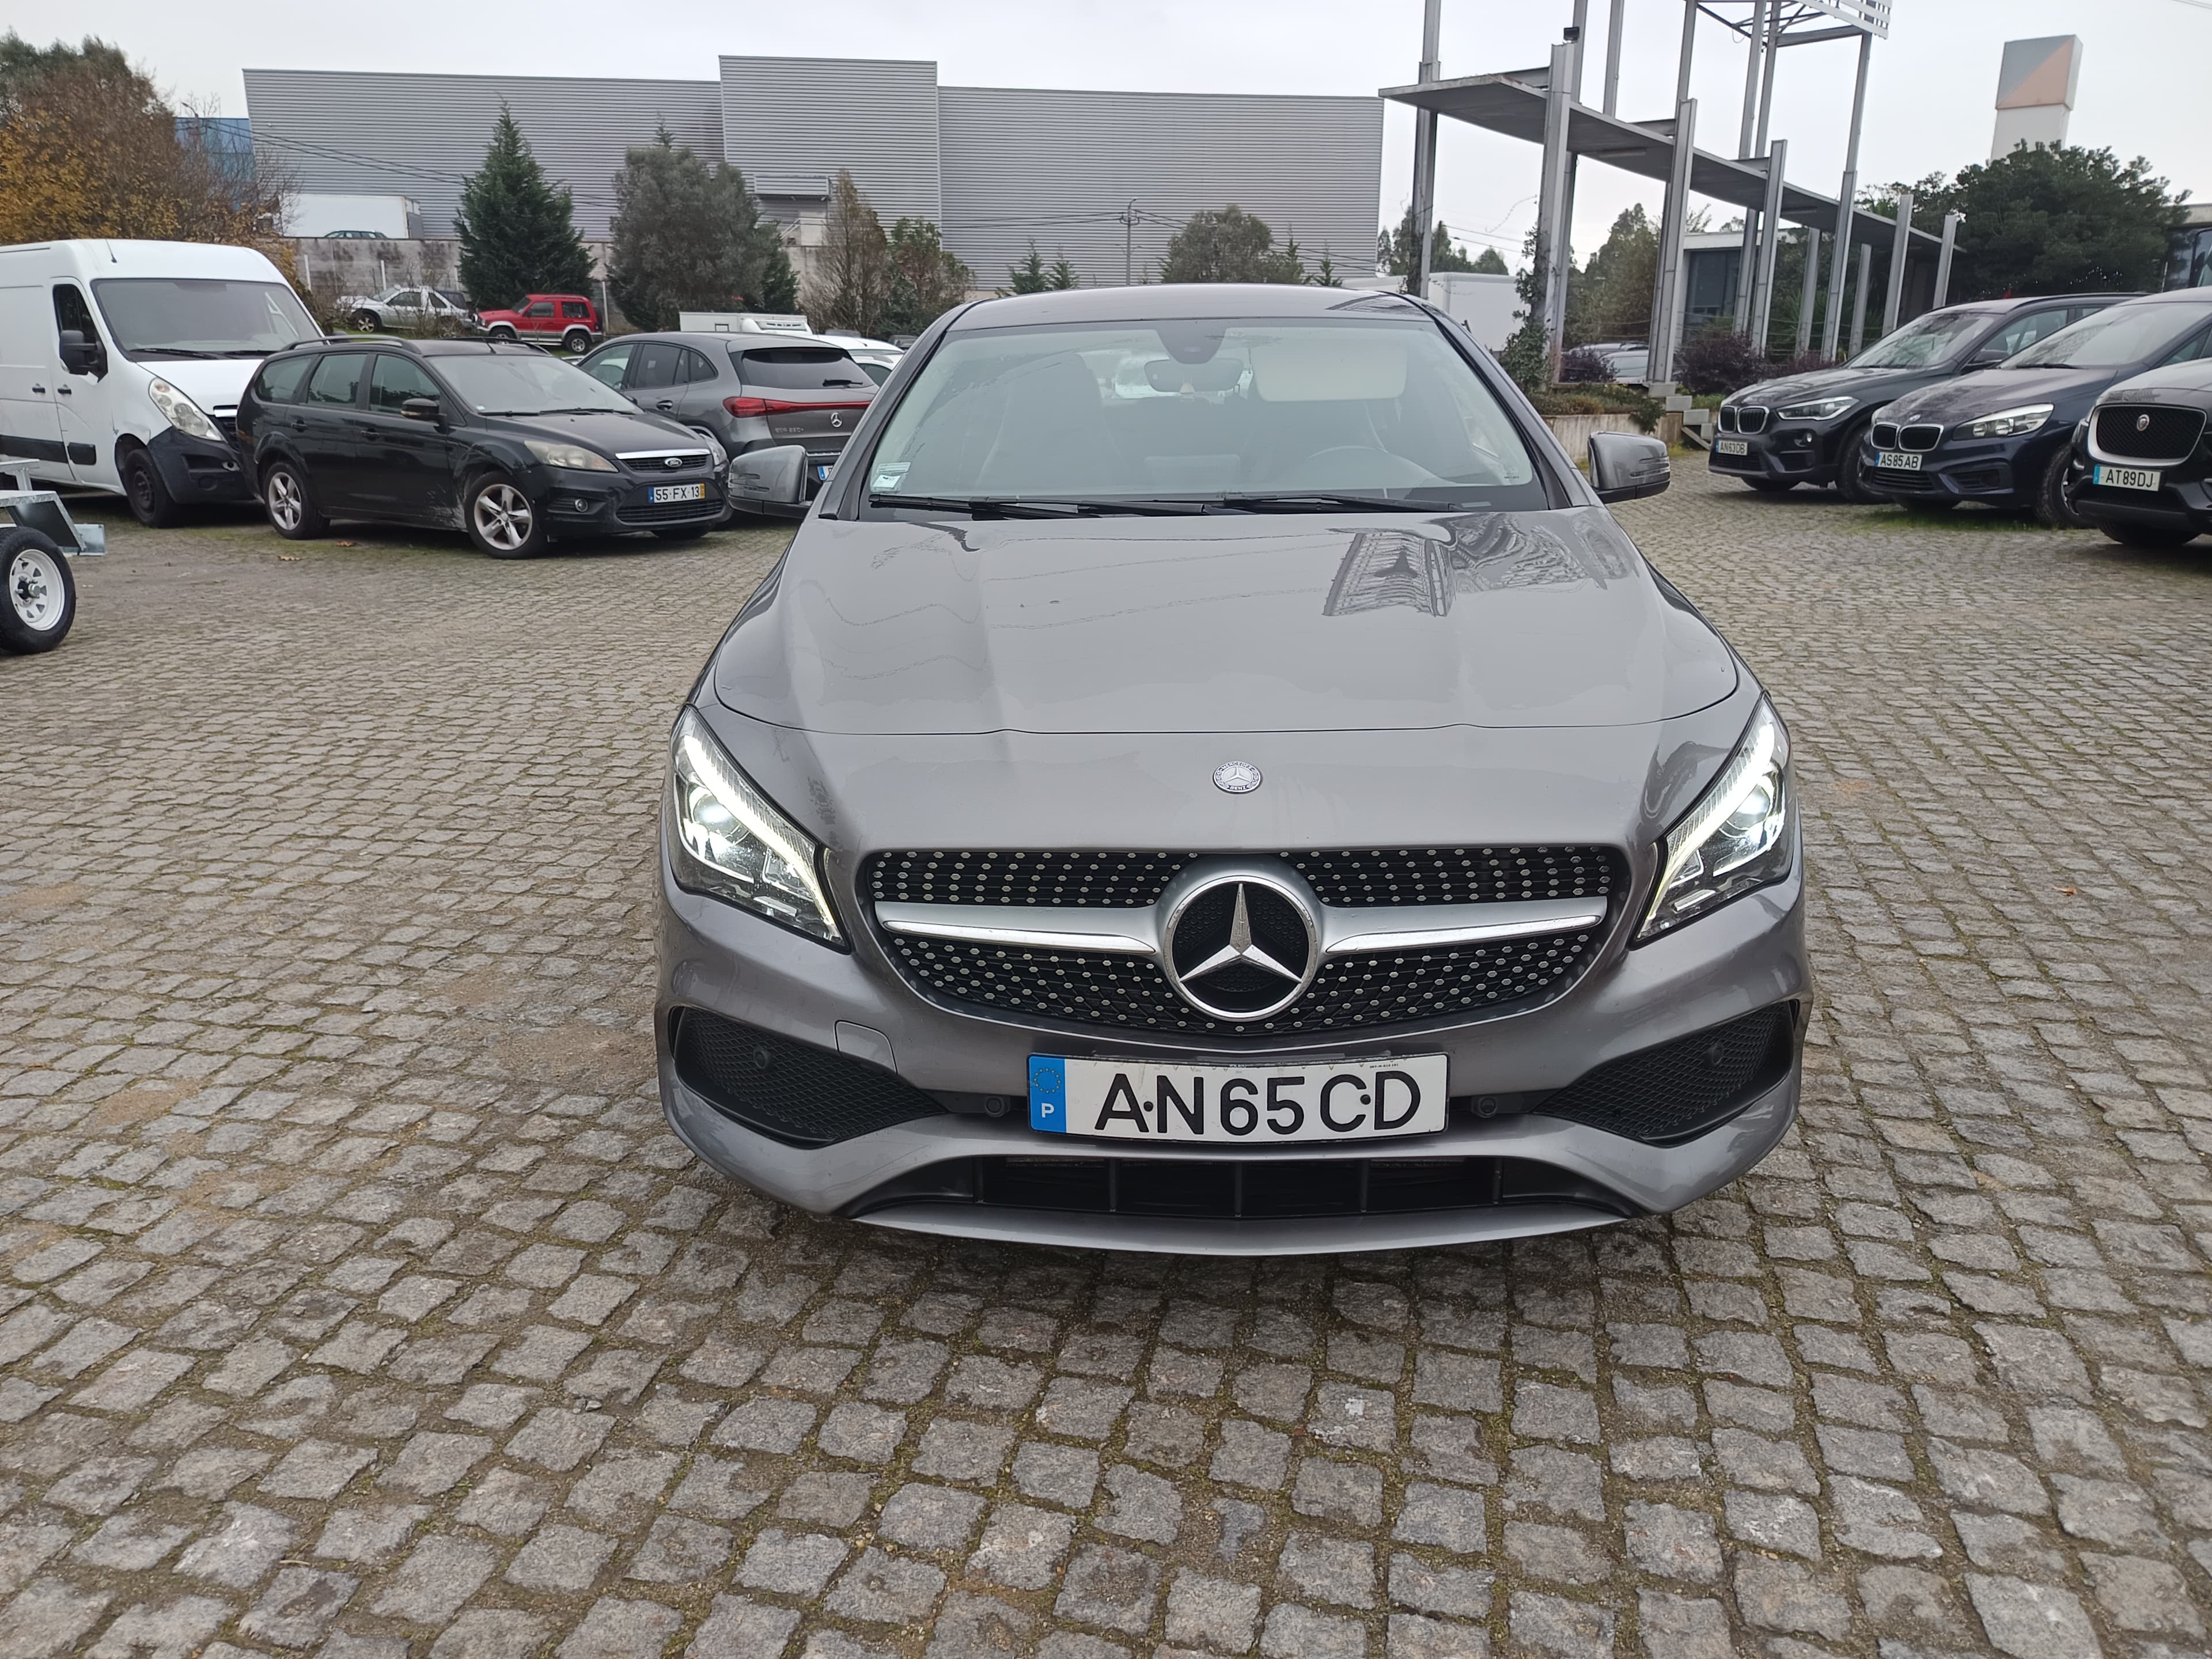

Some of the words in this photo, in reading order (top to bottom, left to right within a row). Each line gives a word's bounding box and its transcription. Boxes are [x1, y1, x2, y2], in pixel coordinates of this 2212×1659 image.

[1880, 454, 1919, 468] AS85AB
[2105, 468, 2154, 487] AT89DJ
[1041, 1102, 1055, 1119] P
